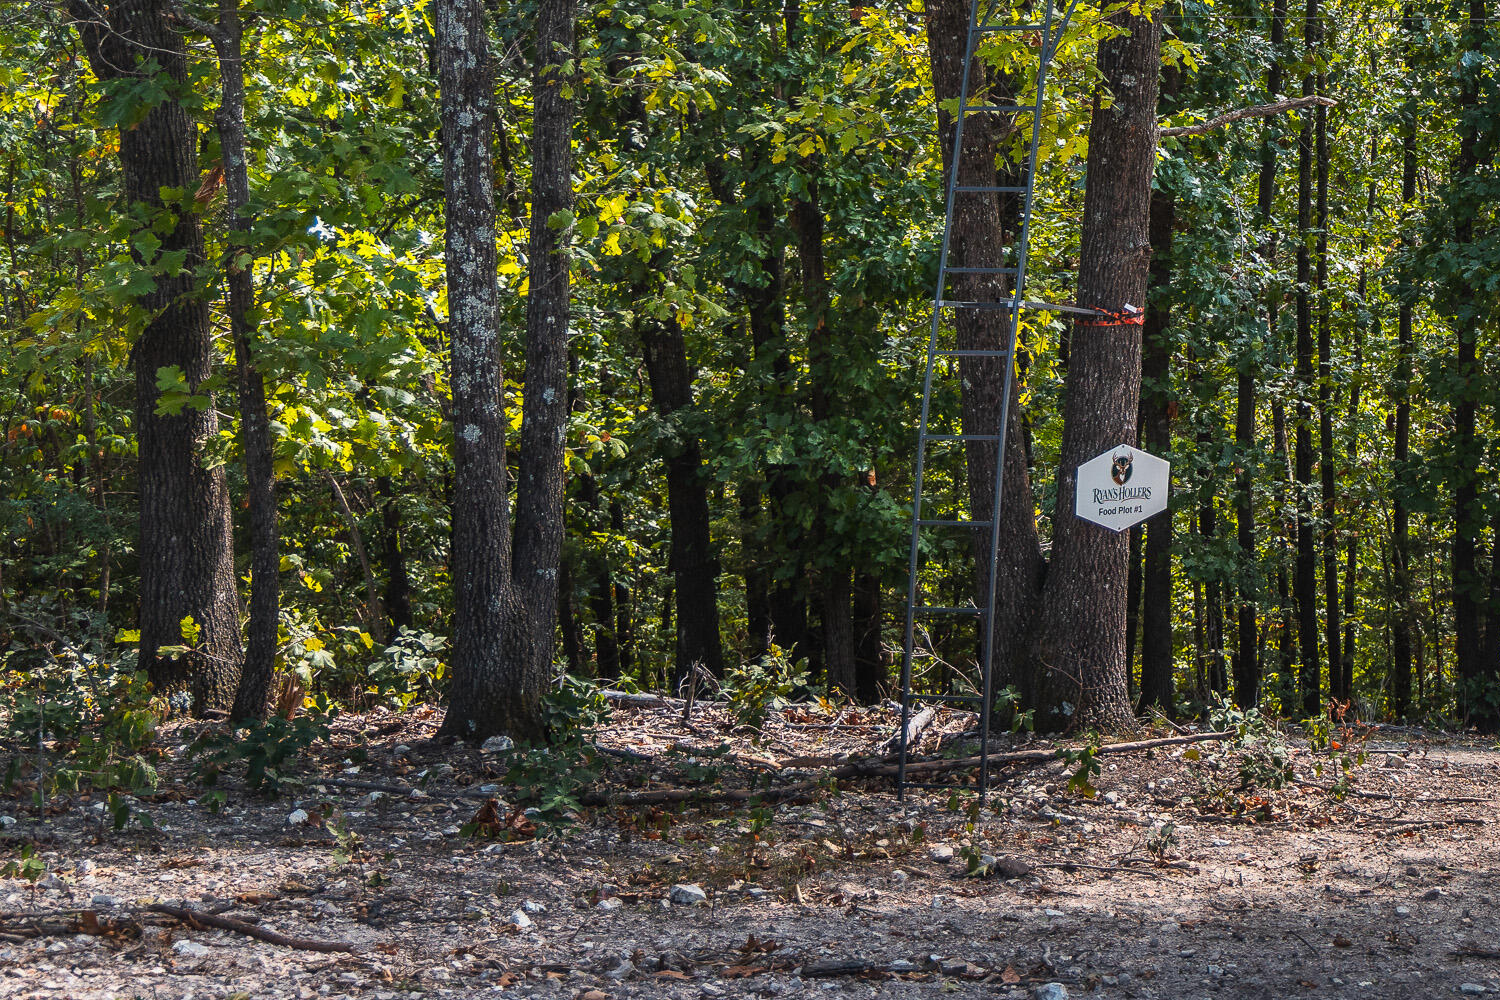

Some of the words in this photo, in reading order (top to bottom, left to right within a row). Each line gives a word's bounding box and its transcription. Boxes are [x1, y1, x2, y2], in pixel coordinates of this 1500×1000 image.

[1093, 487, 1118, 504] RYAN'S
[1118, 486, 1152, 501] HOLLERS
[1099, 507, 1117, 516] Food
[1118, 506, 1133, 515] Plot
[1134, 505, 1143, 513] #1
